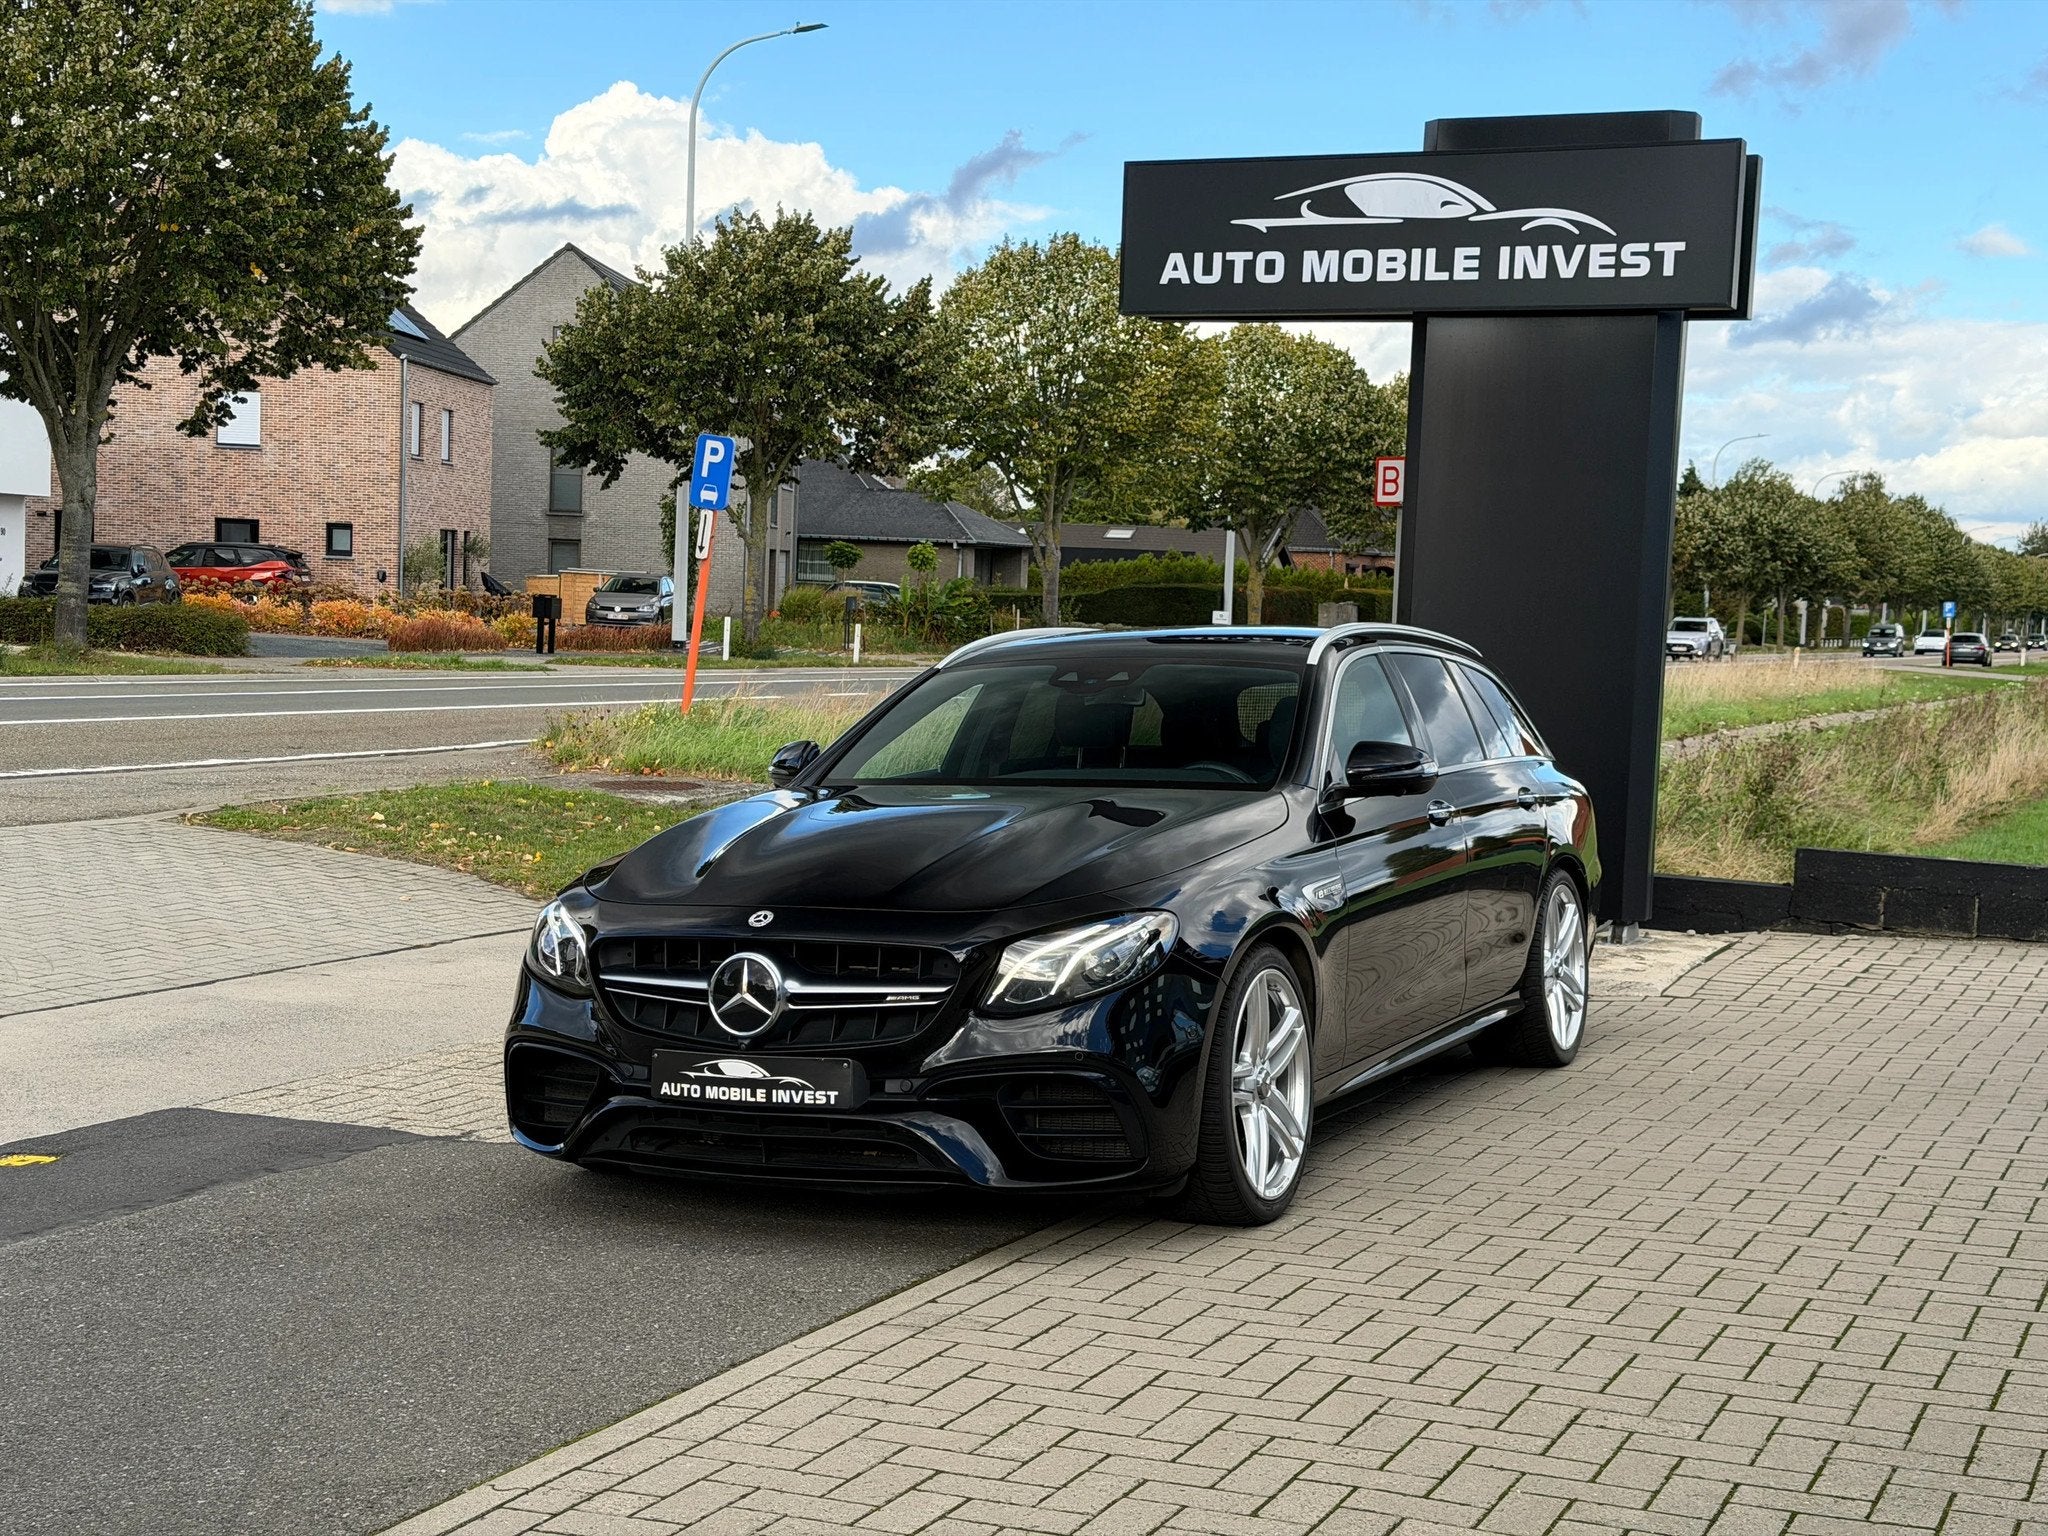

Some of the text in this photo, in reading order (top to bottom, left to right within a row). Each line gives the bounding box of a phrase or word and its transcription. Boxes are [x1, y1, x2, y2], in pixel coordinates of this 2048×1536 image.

[1160, 241, 1687, 285] AUTO MOBILE INVEST
[701, 440, 725, 478] P
[1382, 466, 1400, 496] B
[660, 1081, 839, 1105] AUTO MOBILE INVEST
